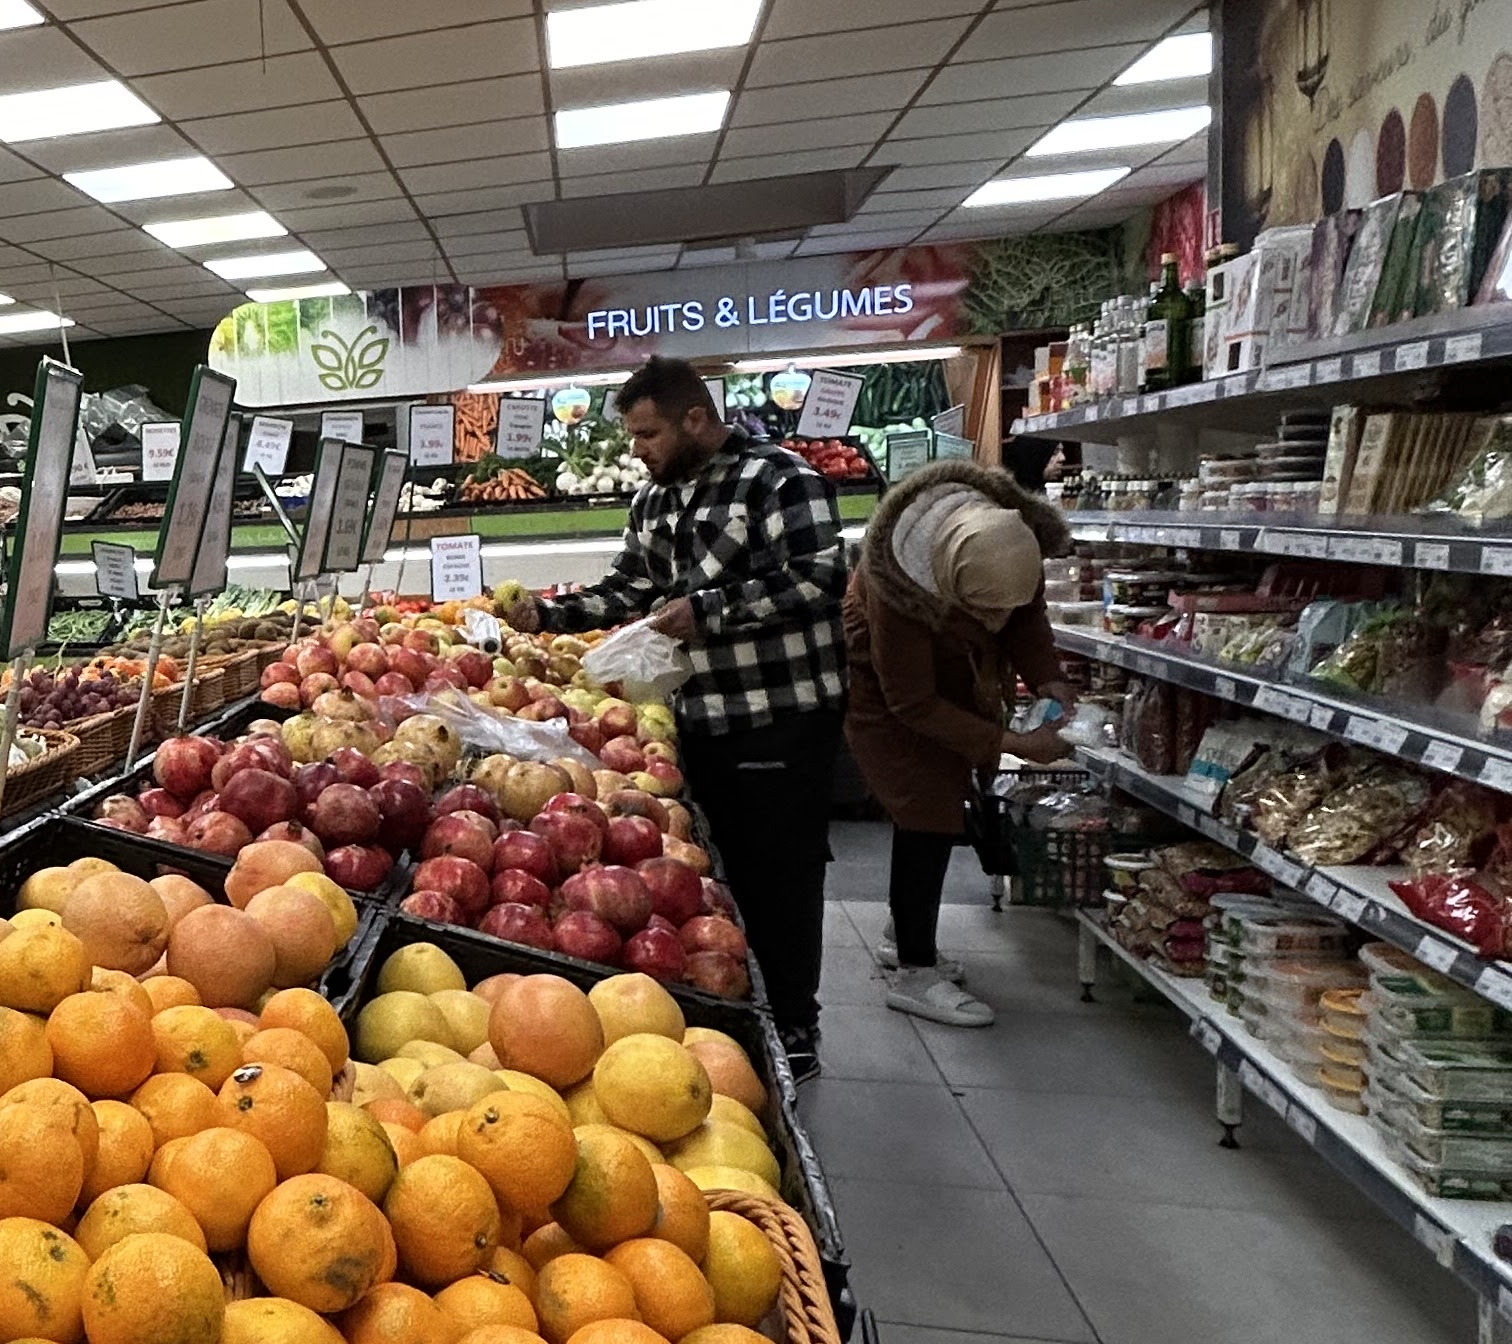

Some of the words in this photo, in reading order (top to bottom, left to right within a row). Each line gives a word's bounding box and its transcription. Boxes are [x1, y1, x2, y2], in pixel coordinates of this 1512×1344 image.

[587, 301, 705, 340] FRUITS
[714, 296, 740, 329] &
[748, 284, 914, 326] LÉGUMES
[436, 540, 474, 551] TOMATE
